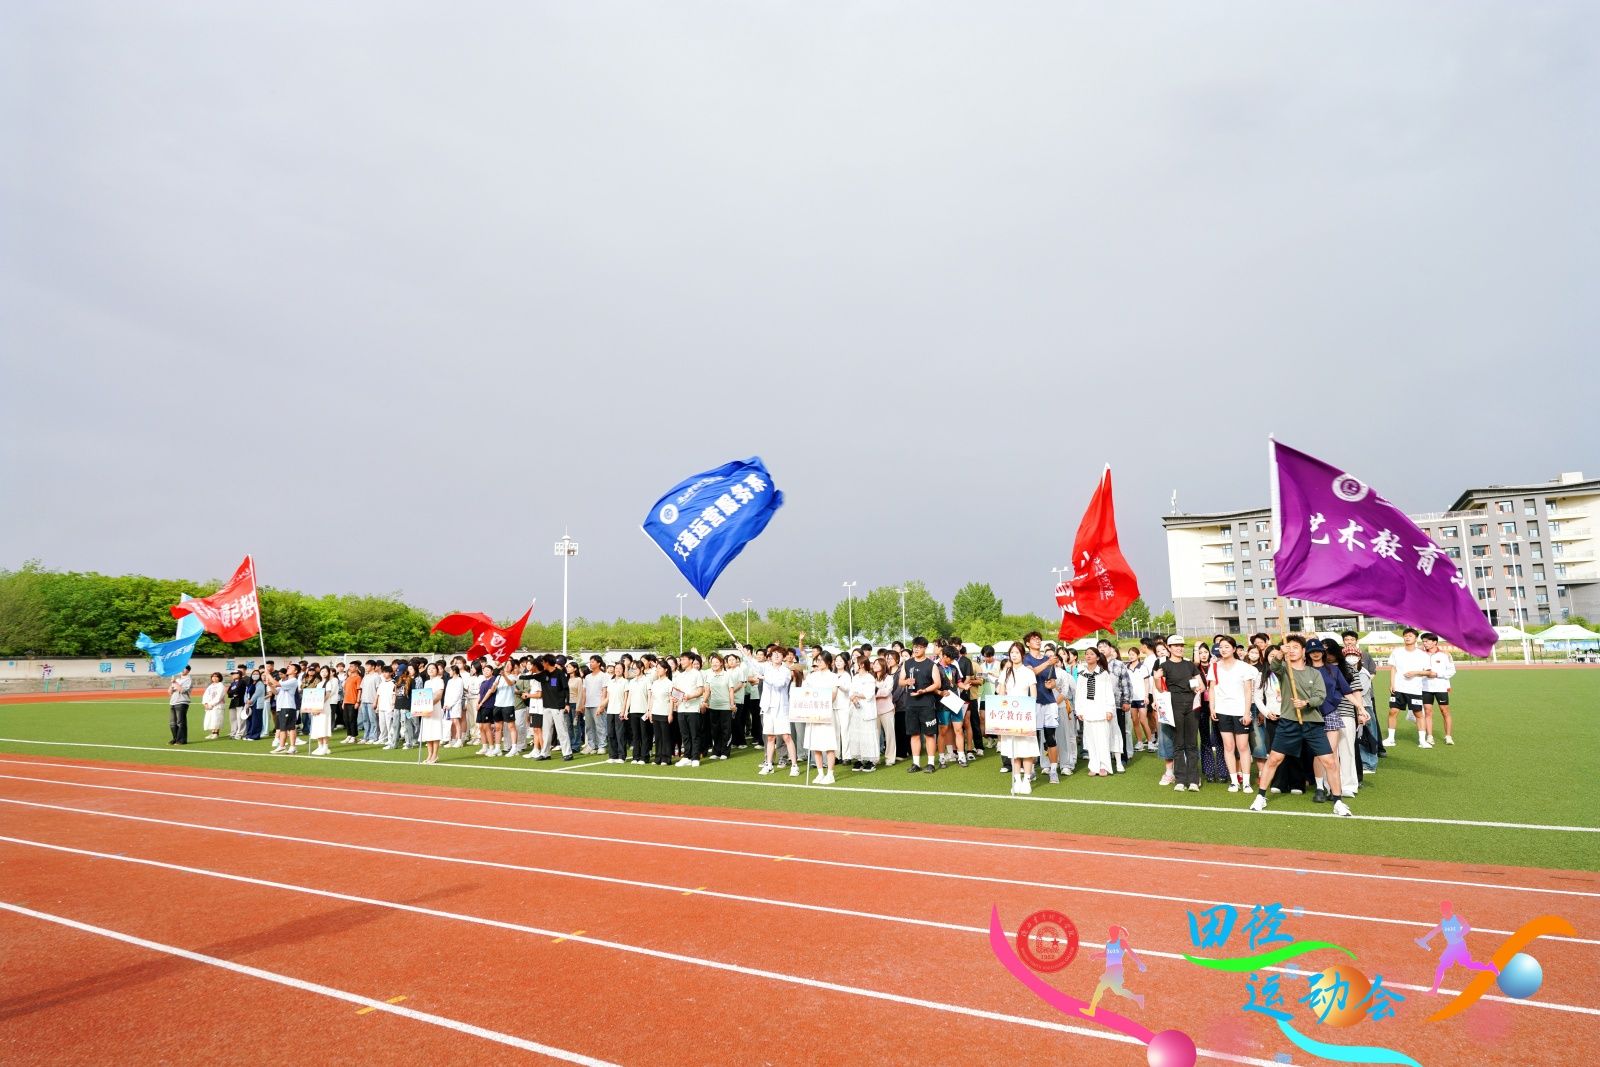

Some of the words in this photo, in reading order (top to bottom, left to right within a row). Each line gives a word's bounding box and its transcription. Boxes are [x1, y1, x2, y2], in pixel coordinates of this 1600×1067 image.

[674, 473, 767, 561] 交通运营服务系
[989, 709, 1033, 721] 小学教育系
